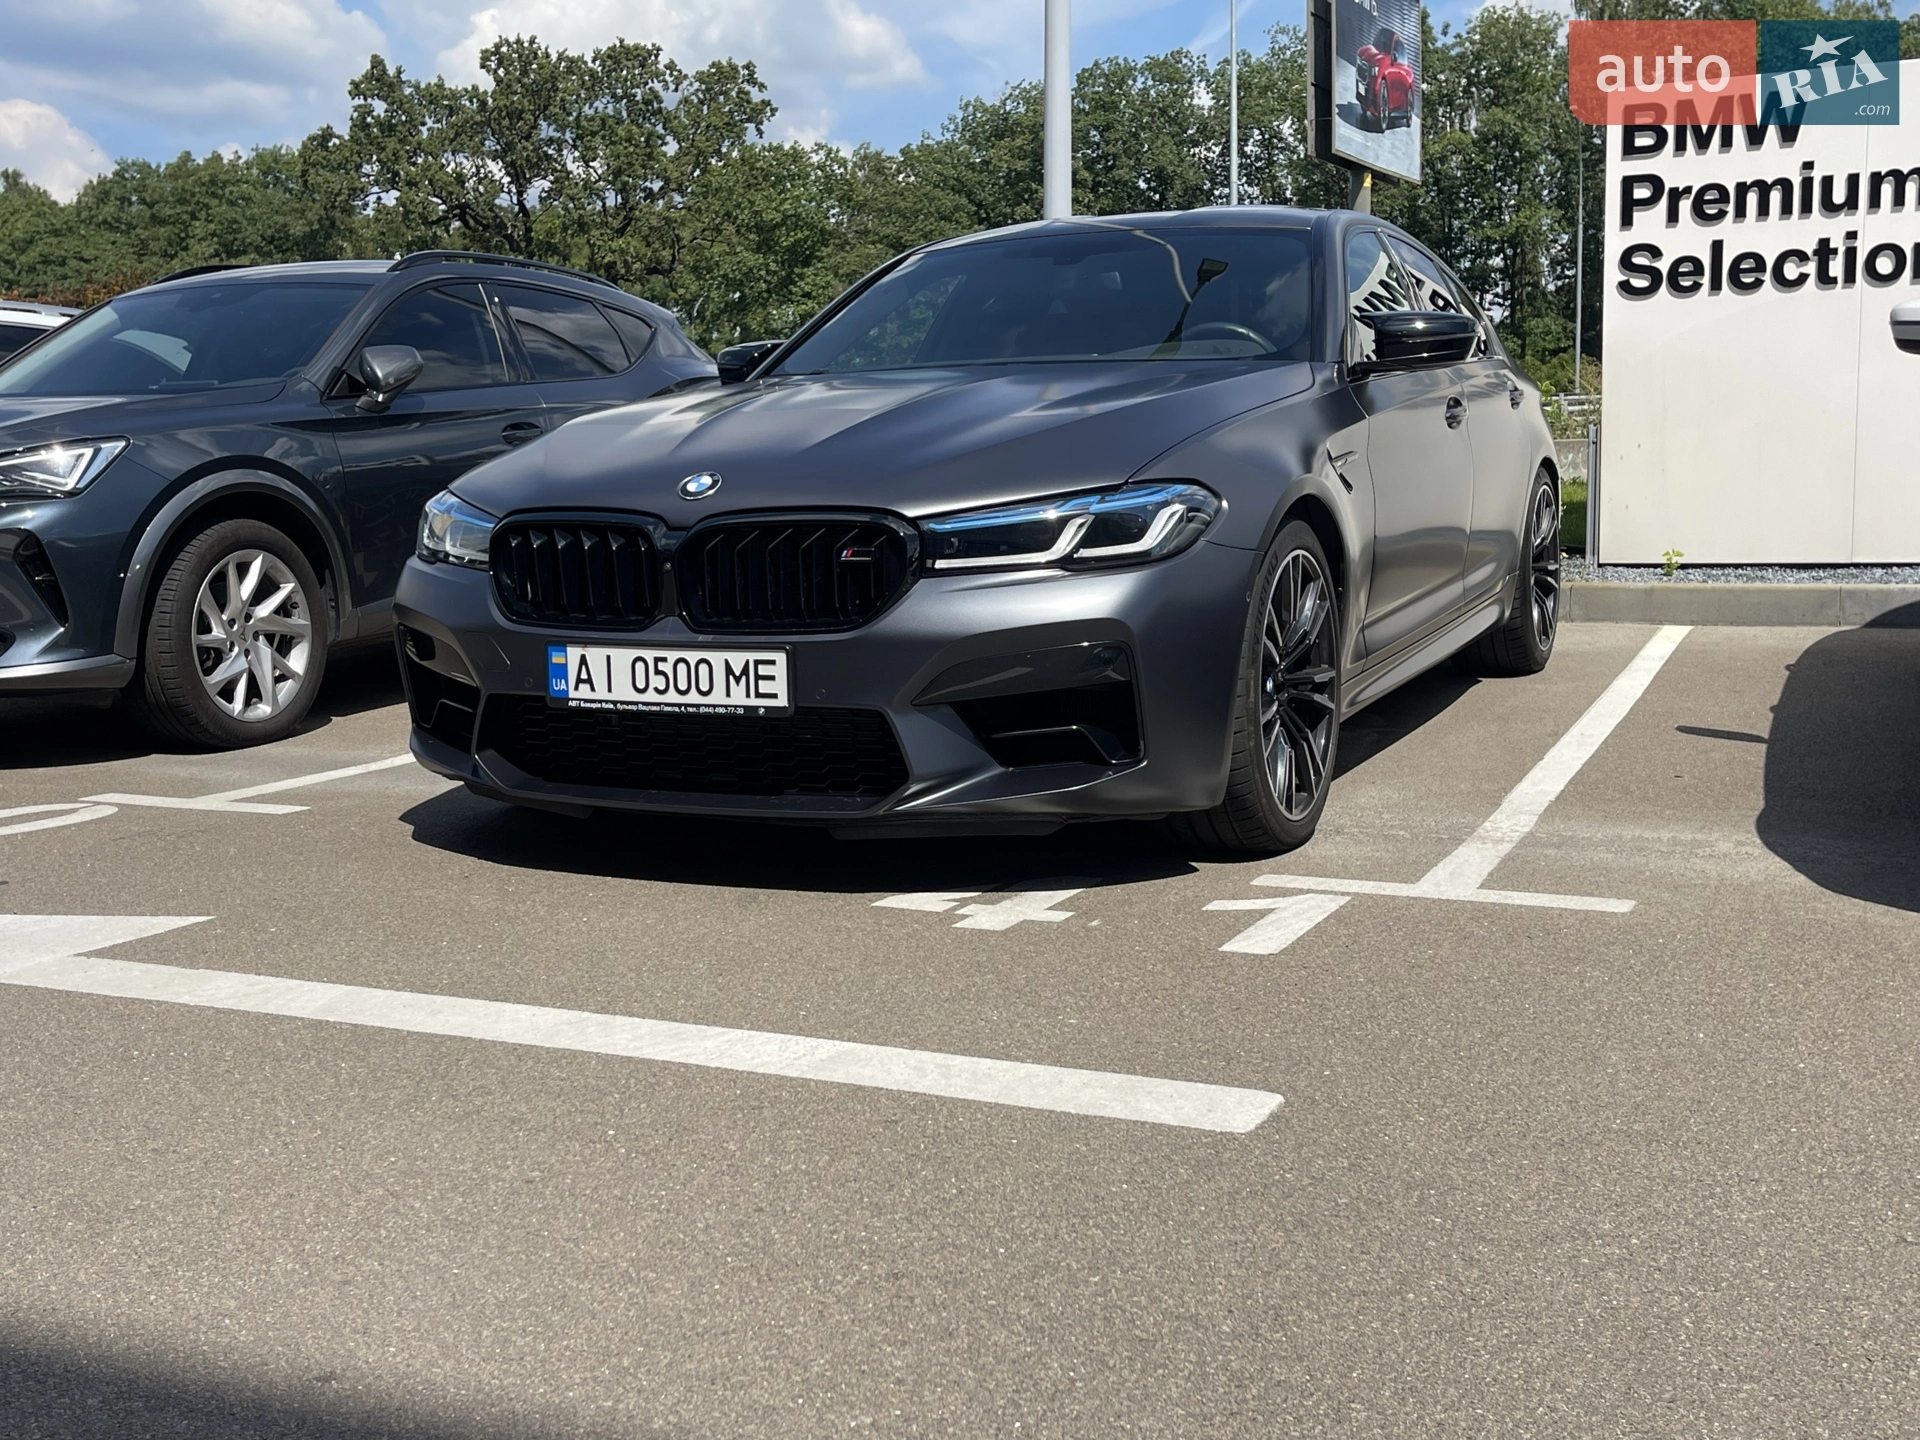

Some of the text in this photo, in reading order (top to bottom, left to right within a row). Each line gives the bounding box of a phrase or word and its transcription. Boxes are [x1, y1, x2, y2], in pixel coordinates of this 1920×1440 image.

[1621, 91, 1809, 161] BMW
[1616, 230, 1920, 300] Selectio
[552, 678, 567, 691] UA
[573, 653, 779, 699] AI 0500 ME
